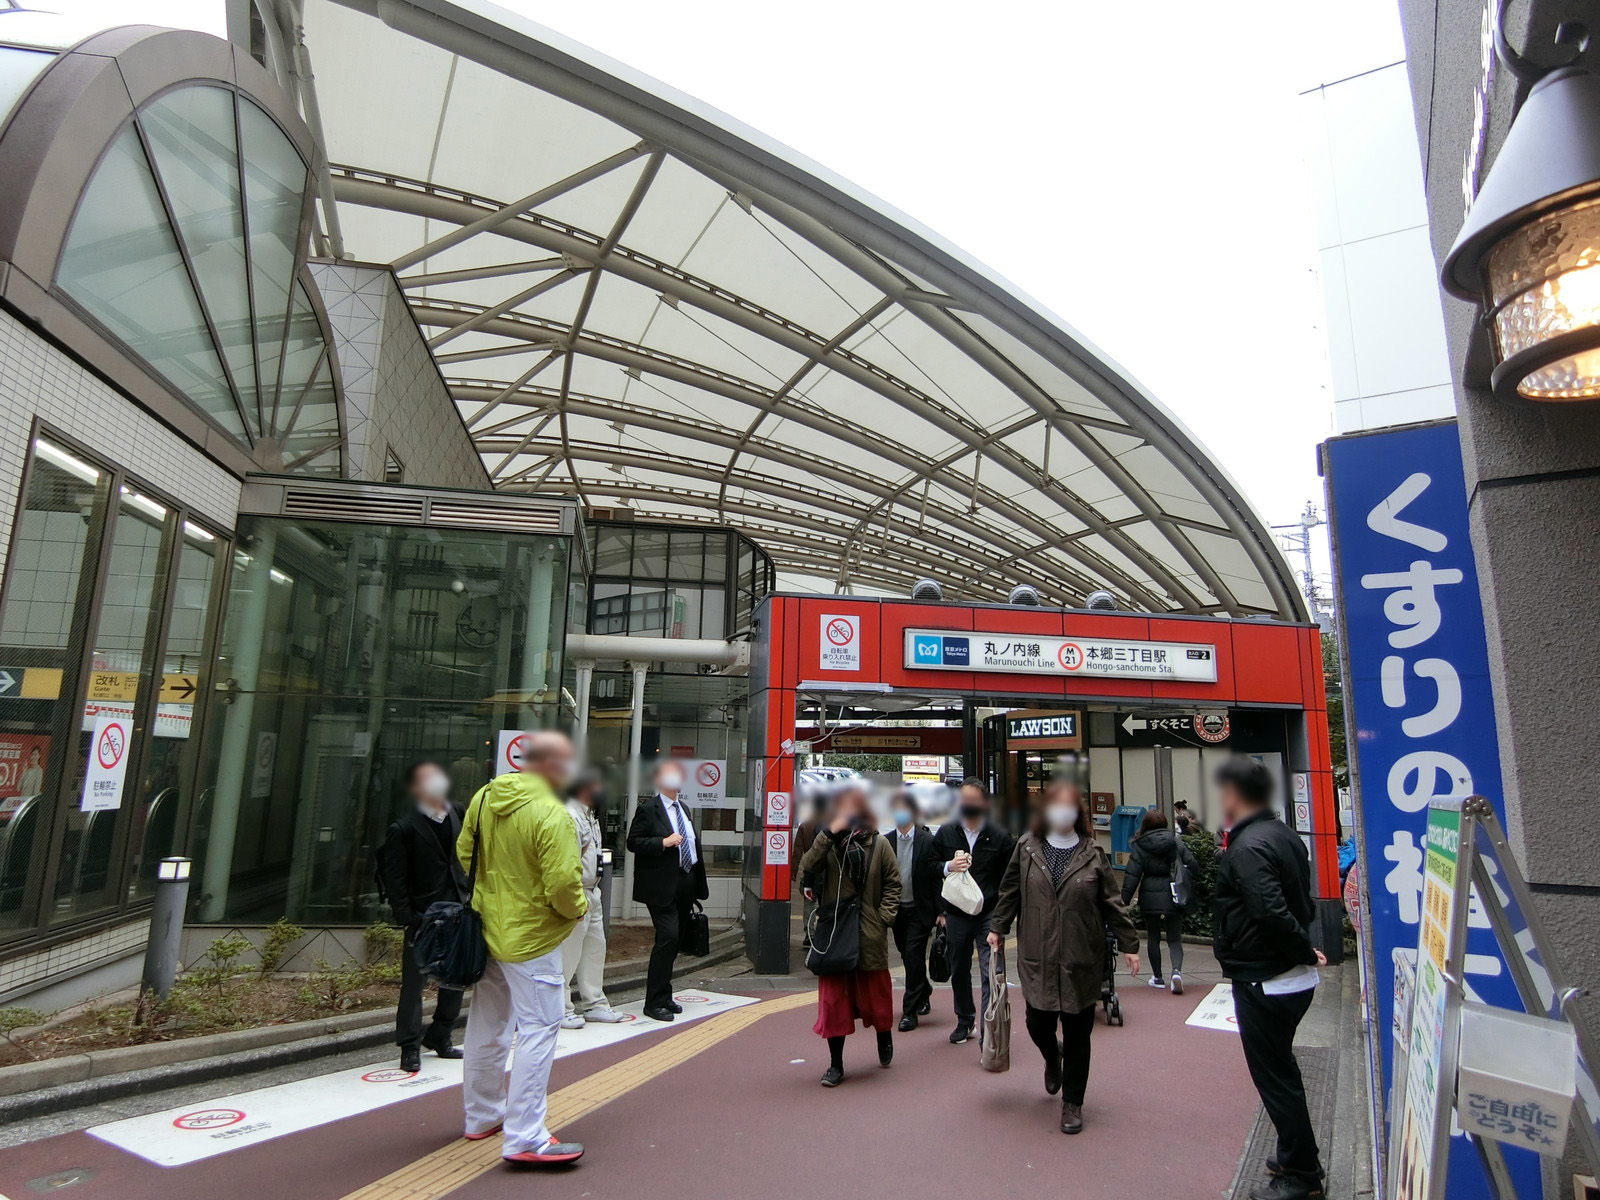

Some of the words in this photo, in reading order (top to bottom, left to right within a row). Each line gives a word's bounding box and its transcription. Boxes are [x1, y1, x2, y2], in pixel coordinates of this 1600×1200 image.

[984, 641, 1041, 657] 丸ノ内線
[1066, 647, 1075, 655] M
[1086, 646, 1167, 664] 本郷三丁目駅
[1201, 651, 1207, 660] 2
[822, 653, 858, 662] 乗り入れ禁止
[984, 656, 1035, 667] Marunouchi
[1037, 659, 1055, 669] Line
[1065, 656, 1076, 665] 21
[1086, 661, 1157, 673] Hongo-sanchome
[1159, 665, 1175, 674] Sta.
[95, 675, 120, 687] 改札
[1010, 717, 1073, 737] LAWSON
[1150, 718, 1191, 730] すぐそこ
[1468, 1093, 1557, 1129] ご自由に
[1476, 1112, 1542, 1142] どうぞ
